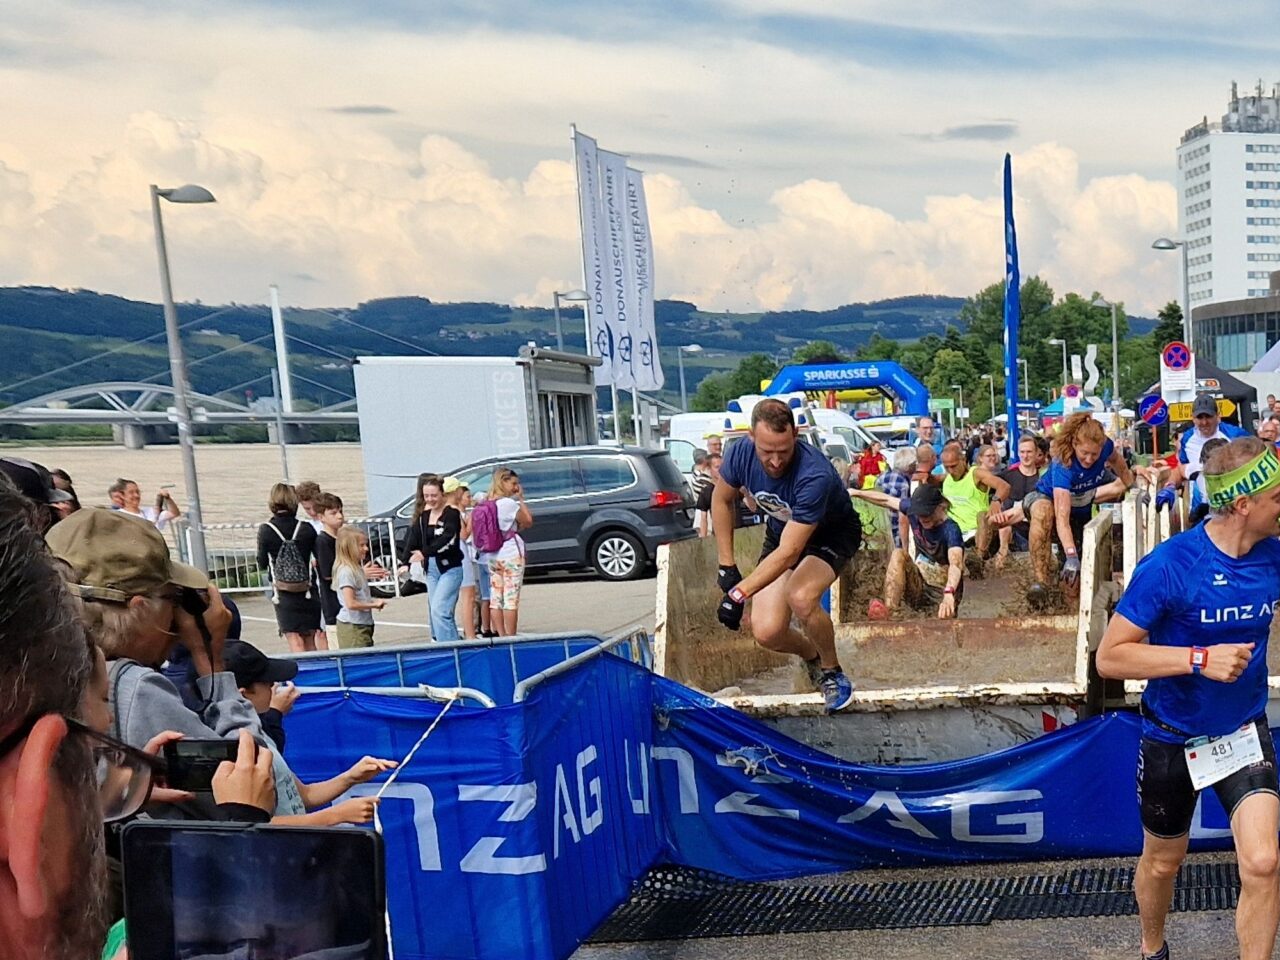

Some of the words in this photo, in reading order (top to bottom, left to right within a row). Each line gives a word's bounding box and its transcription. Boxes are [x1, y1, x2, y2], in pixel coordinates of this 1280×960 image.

[804, 368, 867, 381] SPARKASSE
[492, 370, 520, 452] ICKETS
[1201, 604, 1254, 623] LINZ
[1211, 741, 1233, 757] 481
[553, 744, 604, 860] AG
[837, 789, 1044, 844] AG
